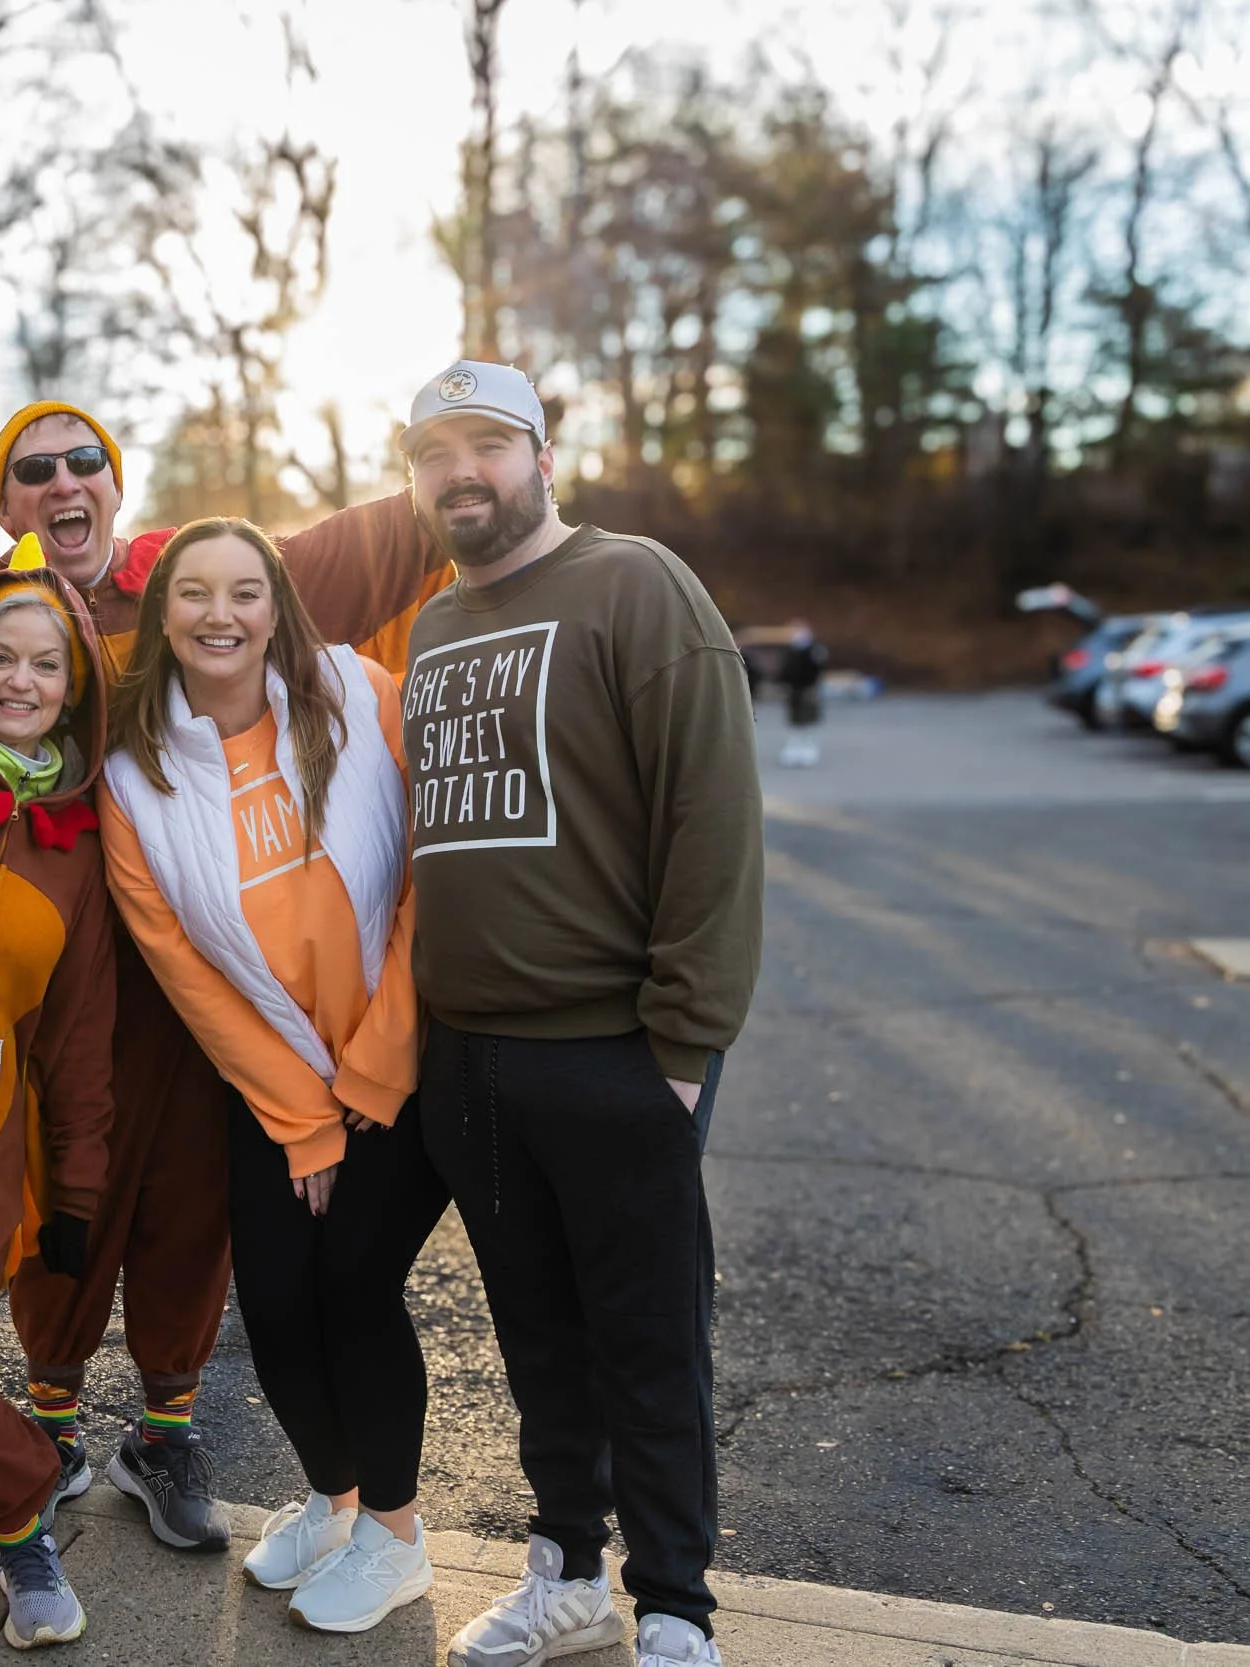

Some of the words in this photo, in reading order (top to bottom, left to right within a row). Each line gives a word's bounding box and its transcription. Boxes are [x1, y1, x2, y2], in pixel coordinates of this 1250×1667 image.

[407, 658, 481, 721] SHE'S
[486, 647, 536, 700] MY
[420, 708, 506, 771] SWEET
[414, 768, 526, 832] POTATO
